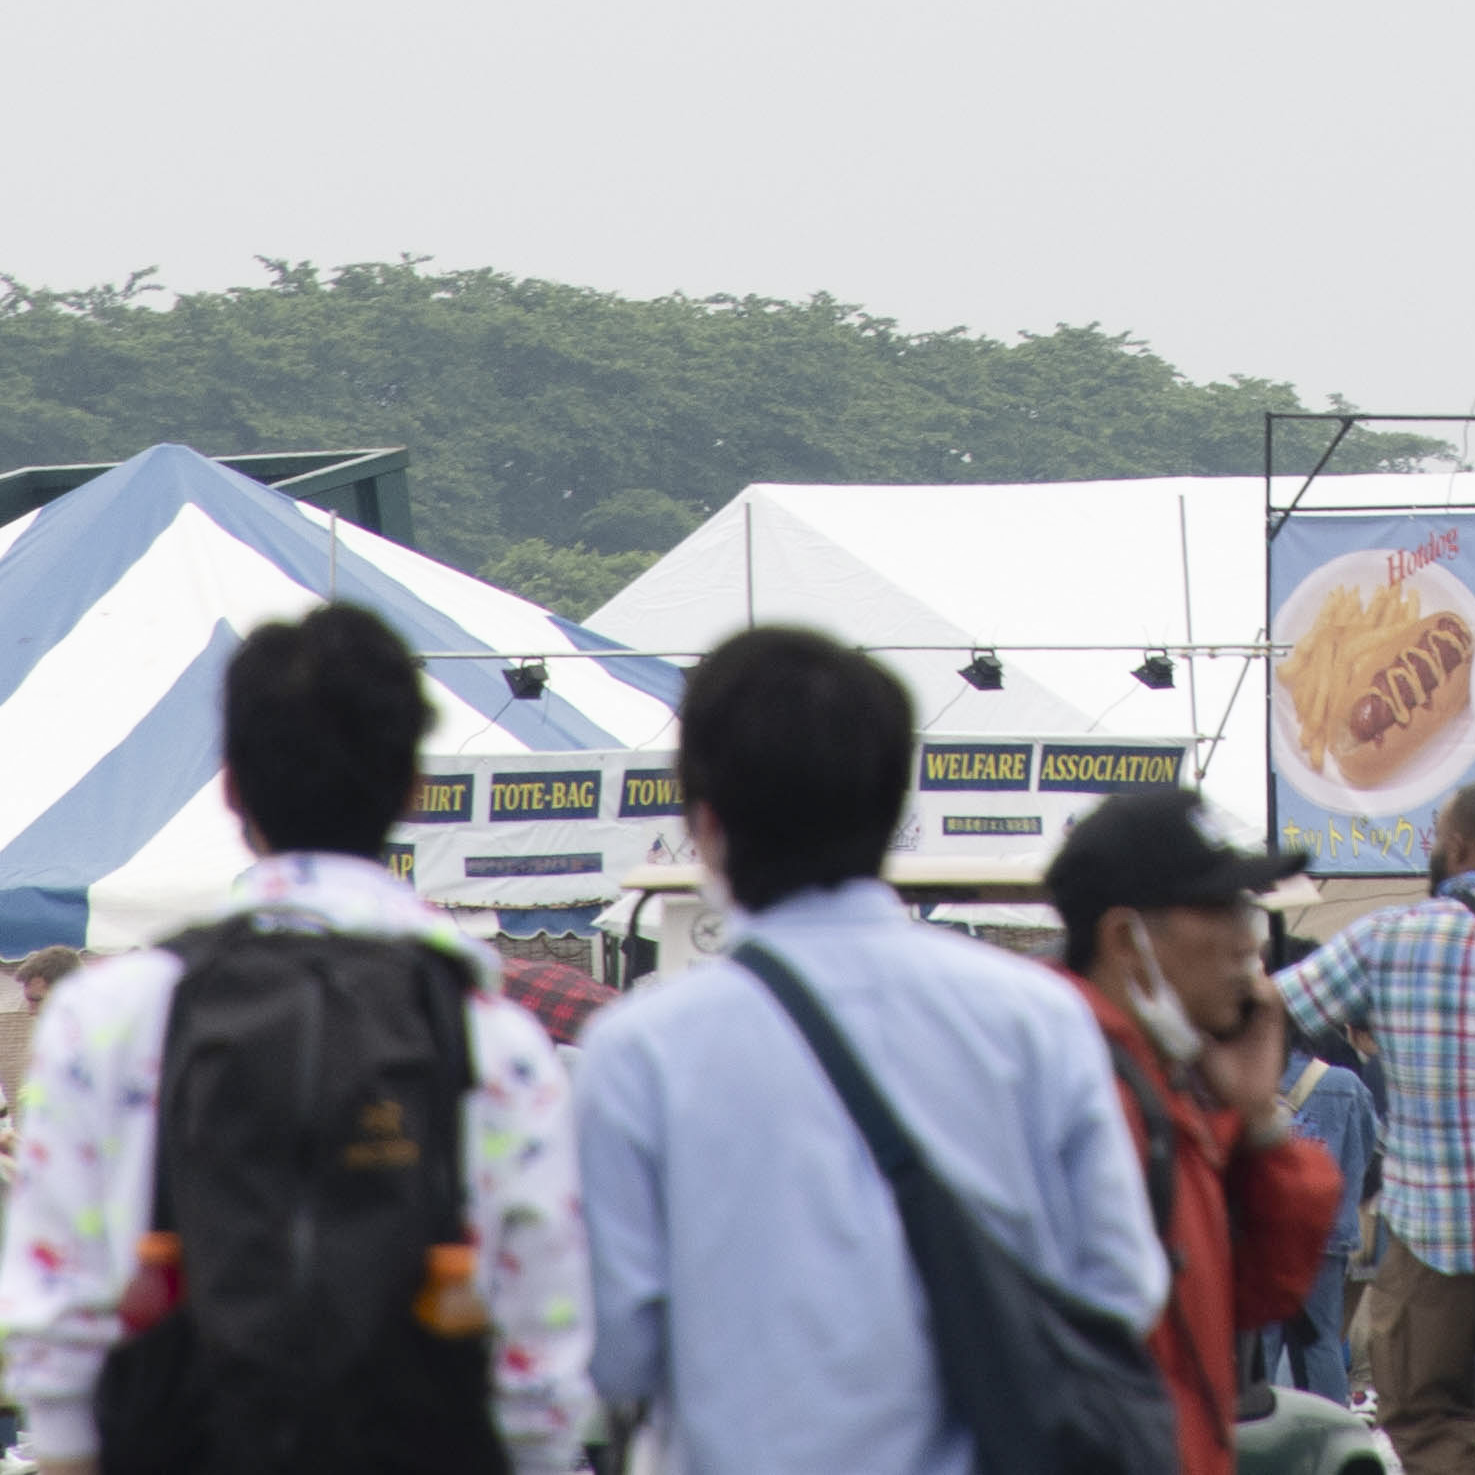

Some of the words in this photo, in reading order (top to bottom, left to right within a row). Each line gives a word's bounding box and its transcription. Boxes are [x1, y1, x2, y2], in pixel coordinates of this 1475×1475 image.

[1387, 528, 1460, 587] Hotdog
[413, 784, 466, 812] HIRT
[491, 781, 595, 811] TOTE-BAG
[926, 752, 1027, 780] WELFARE
[1040, 754, 1179, 783] ASSOCIATION
[386, 853, 414, 879] AP
